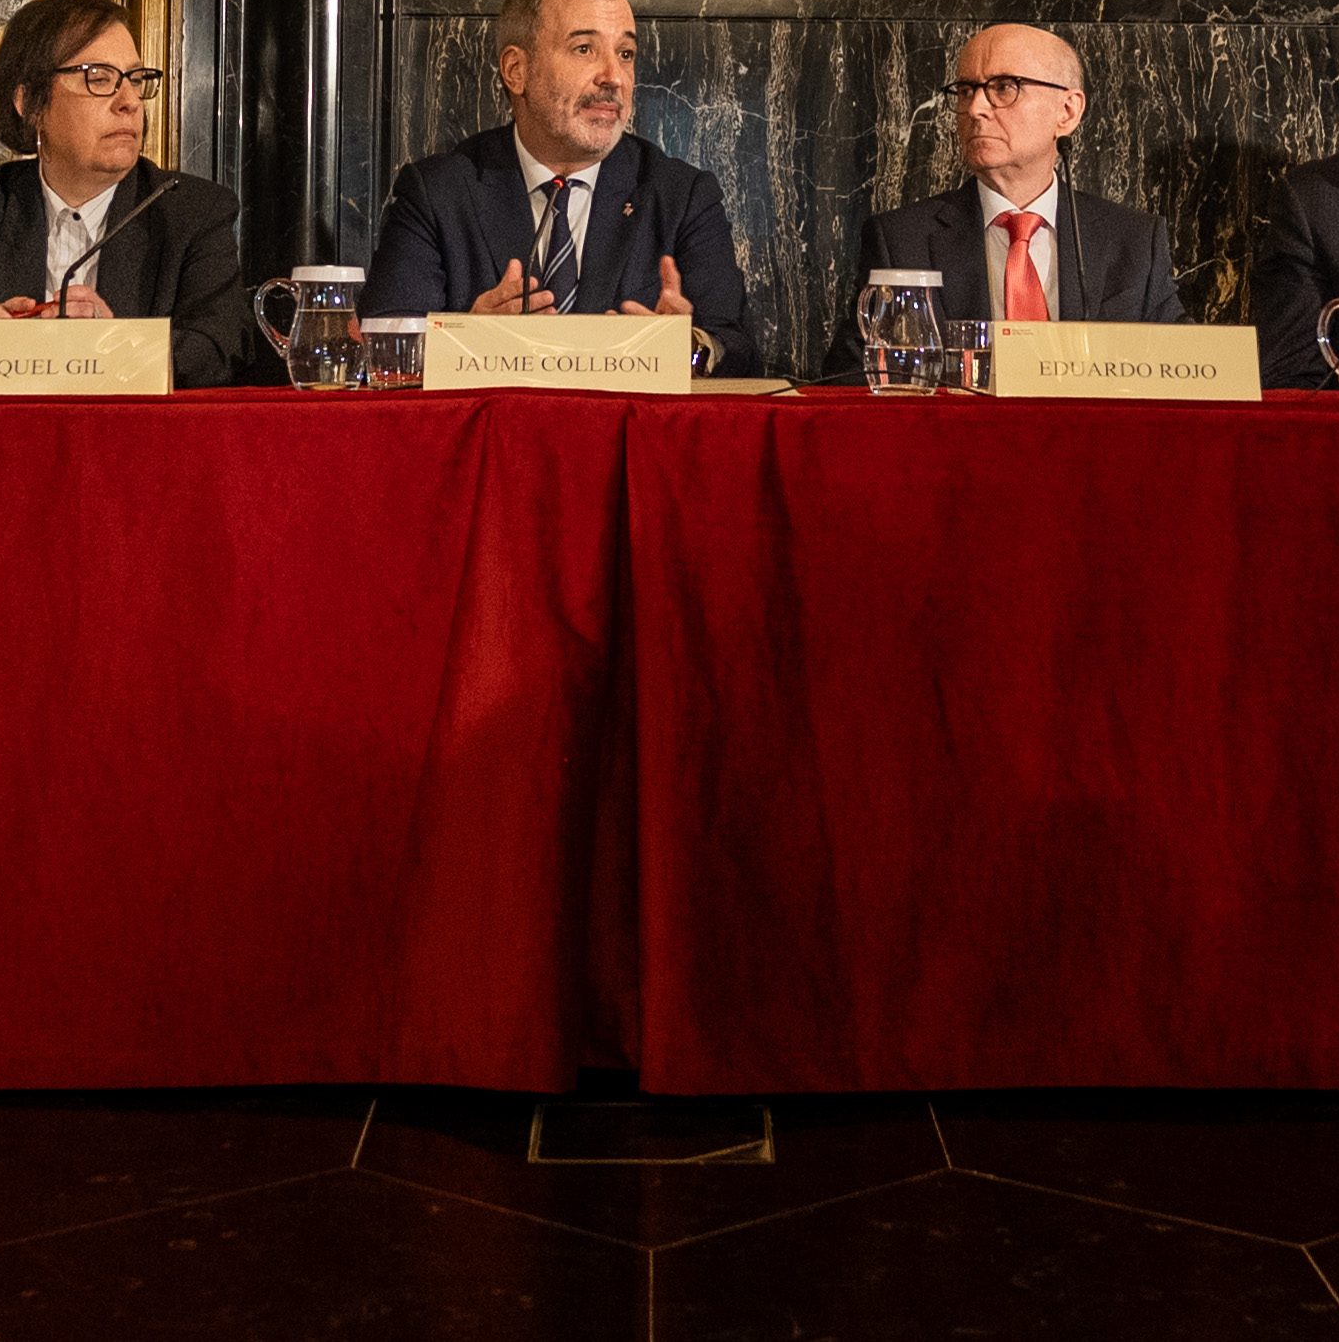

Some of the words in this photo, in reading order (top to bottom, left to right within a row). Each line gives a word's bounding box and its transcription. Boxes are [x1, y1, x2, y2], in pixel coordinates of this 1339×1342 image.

[65, 358, 105, 375] GIL
[455, 355, 535, 372] JAUME
[540, 355, 660, 373] COLLBONI
[1039, 360, 1153, 379] EDUARDO
[1159, 363, 1218, 380] ROJO
